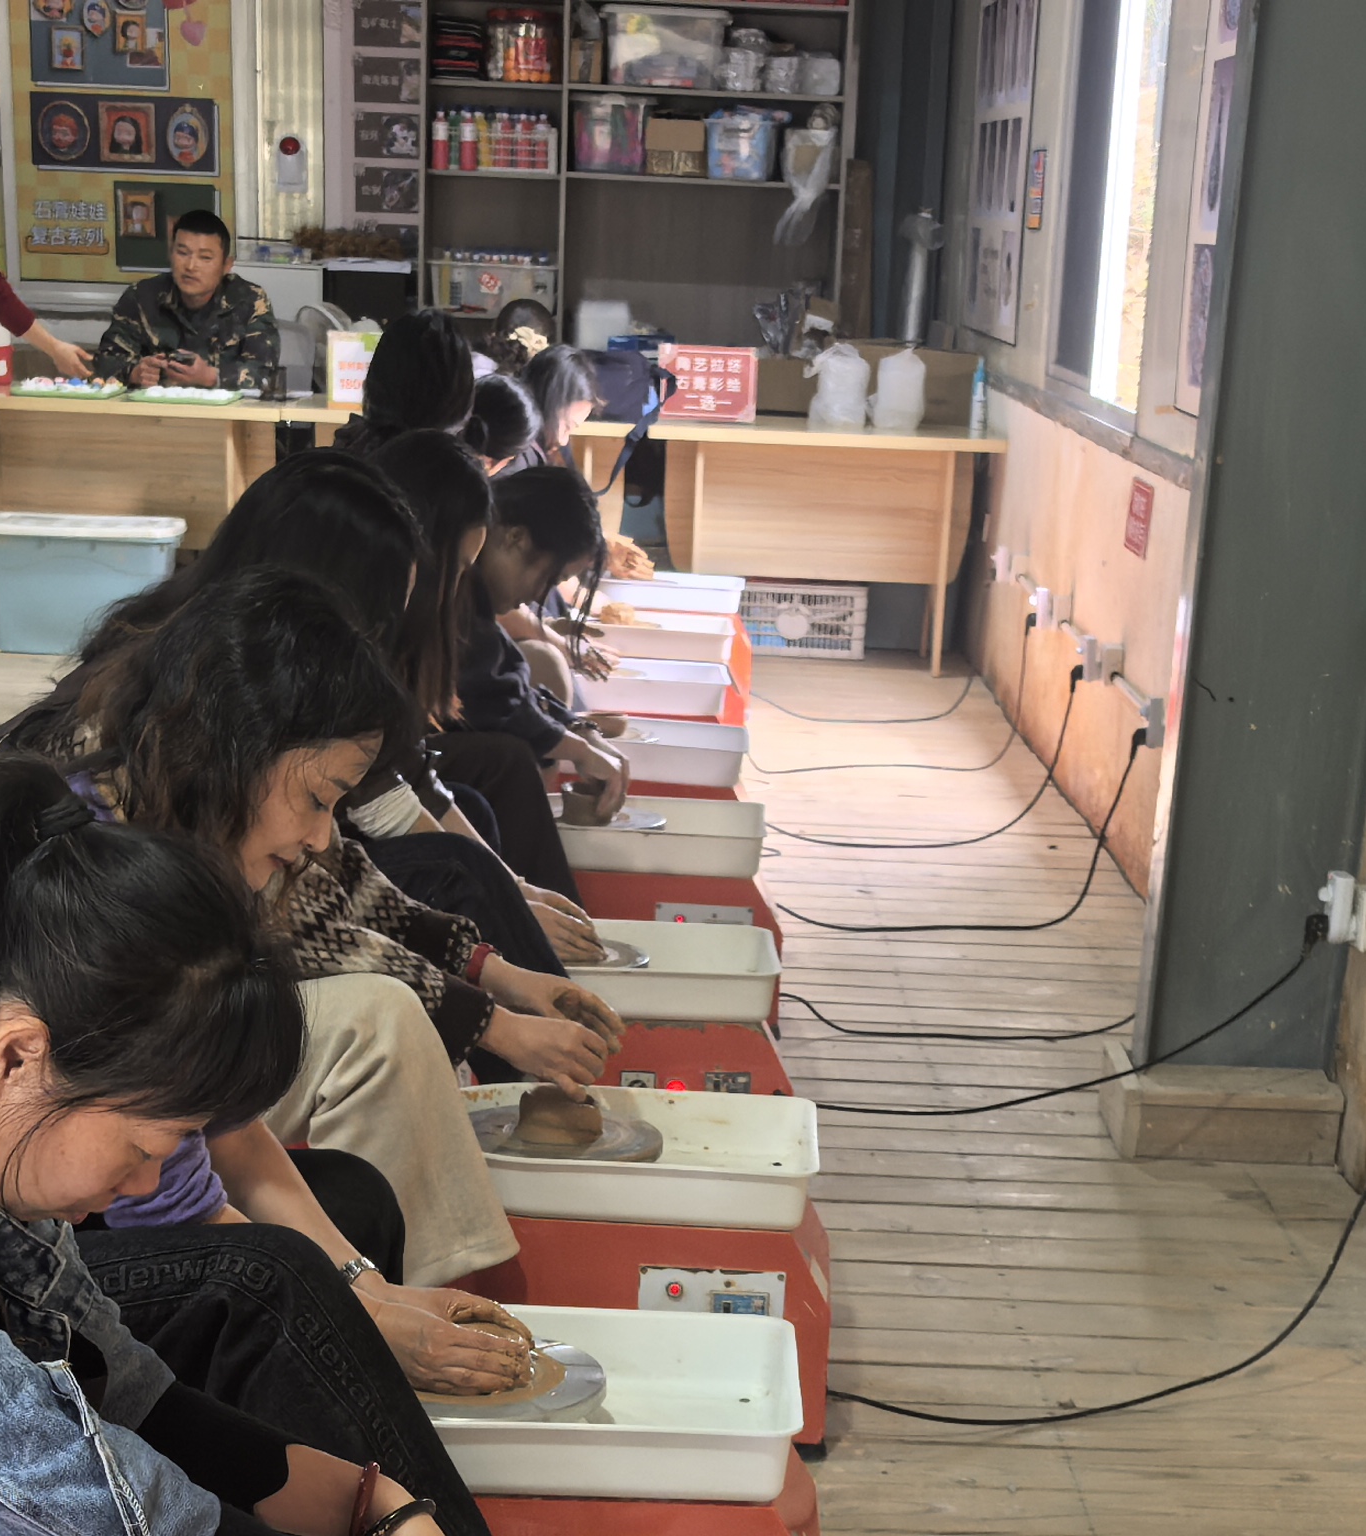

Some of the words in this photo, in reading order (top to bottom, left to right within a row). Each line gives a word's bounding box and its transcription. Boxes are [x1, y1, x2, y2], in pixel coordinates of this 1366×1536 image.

[31, 226, 104, 247] 复古系列
[683, 394, 732, 411] 二选一
